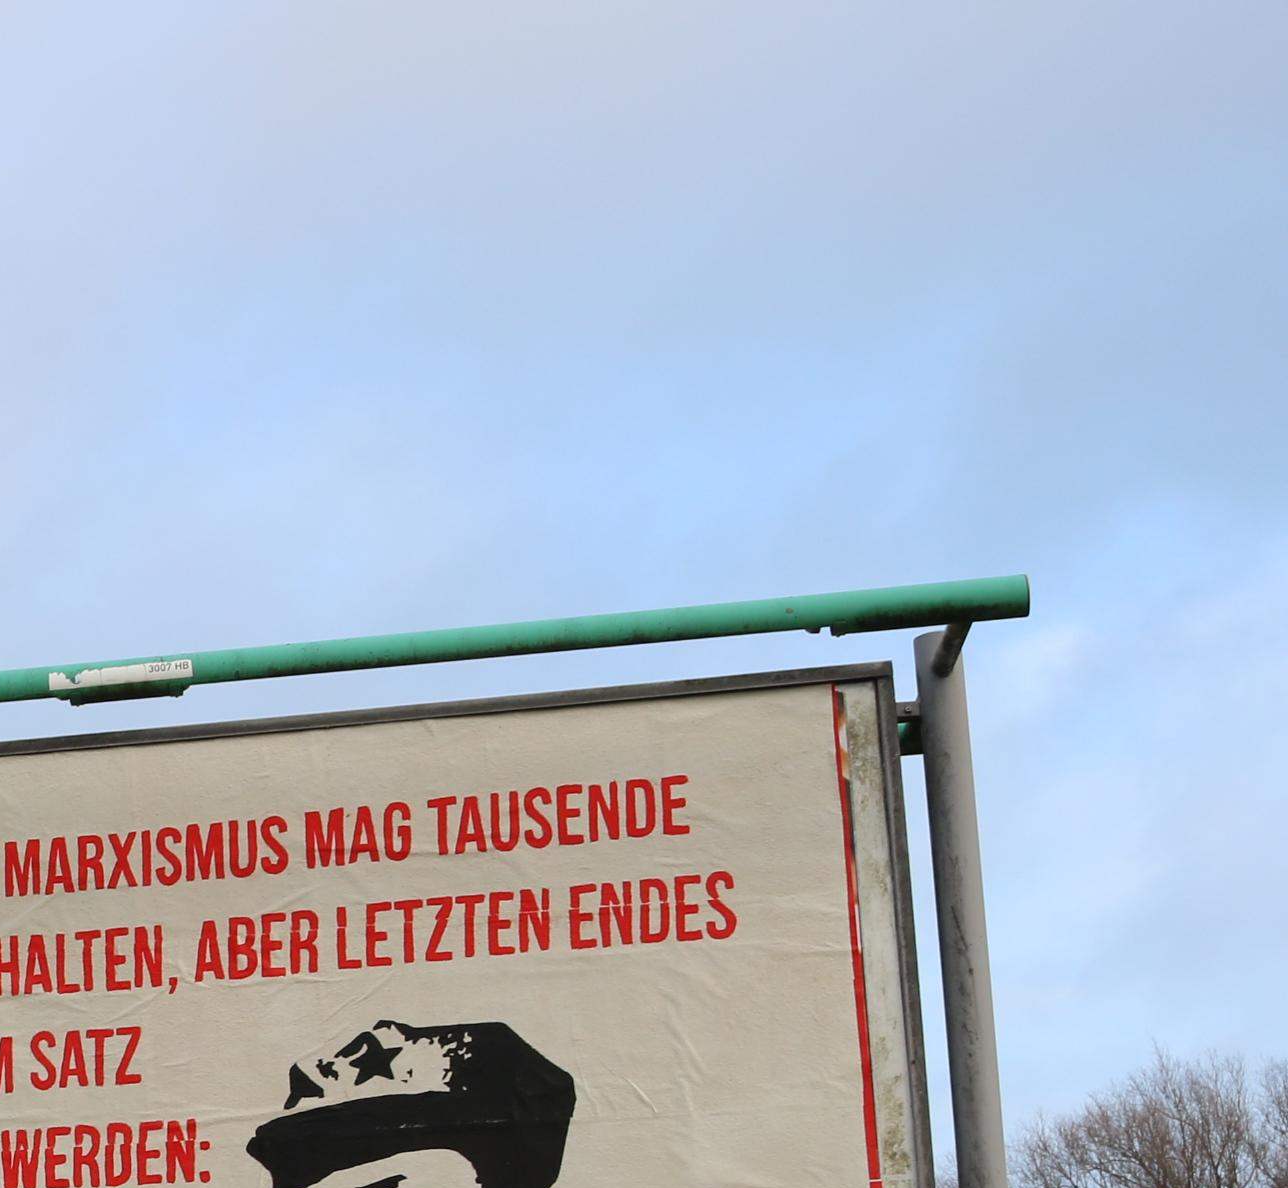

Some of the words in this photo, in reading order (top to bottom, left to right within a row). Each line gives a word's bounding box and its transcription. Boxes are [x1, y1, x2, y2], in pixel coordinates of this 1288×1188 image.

[148, 664, 172, 673] 3007
[174, 661, 190, 670] HB
[4, 815, 291, 897] MARXISMUS
[304, 801, 413, 869] MAG
[427, 774, 692, 857] TAUSENDE
[194, 908, 321, 983] ABER
[336, 887, 552, 970] LETZTEN
[568, 870, 739, 950] ENDES
[30, 1025, 143, 1091] SATZ
